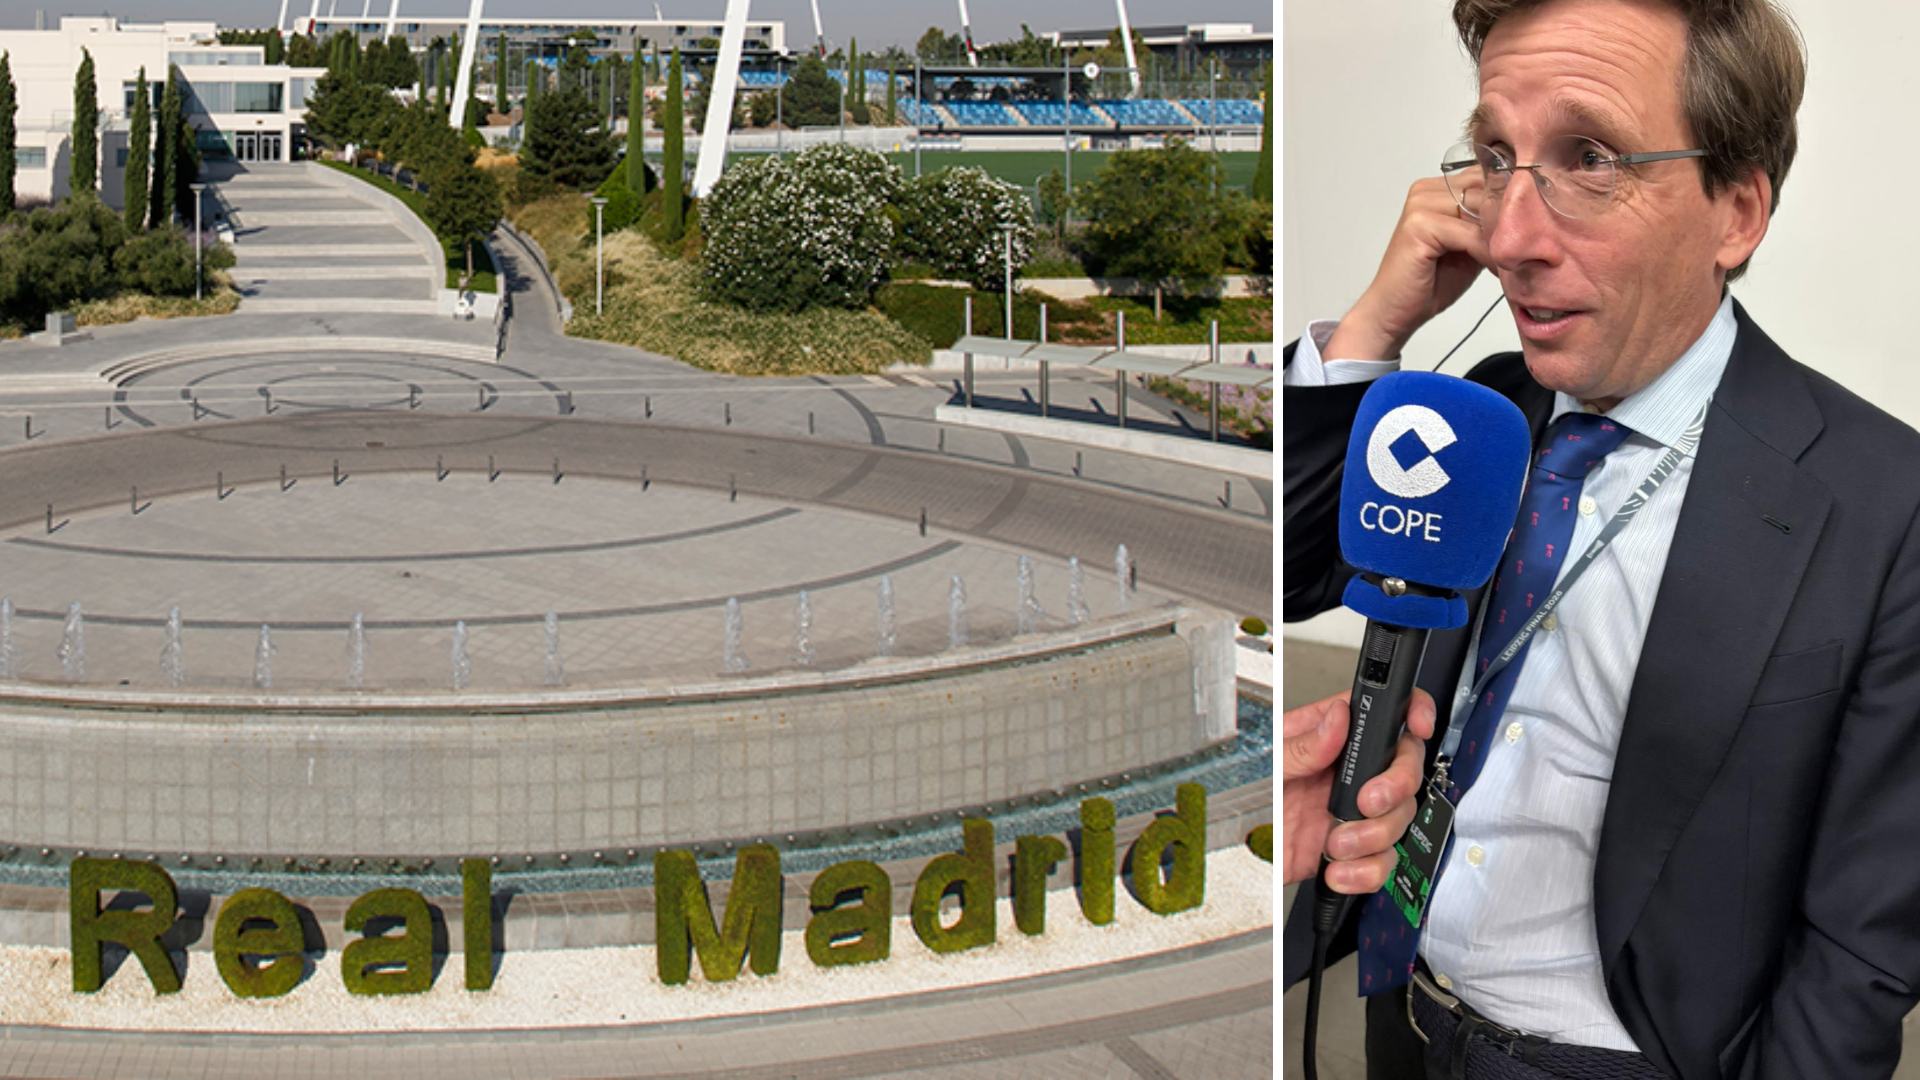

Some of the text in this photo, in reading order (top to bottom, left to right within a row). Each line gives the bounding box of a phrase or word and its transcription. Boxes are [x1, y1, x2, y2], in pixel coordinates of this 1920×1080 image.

[1360, 502, 1442, 542] COPE
[1501, 590, 1563, 661] LEIPZIG FINAL 2026
[1345, 712, 1367, 785] SENNHEISER
[70, 781, 1207, 998] Real Madrid
